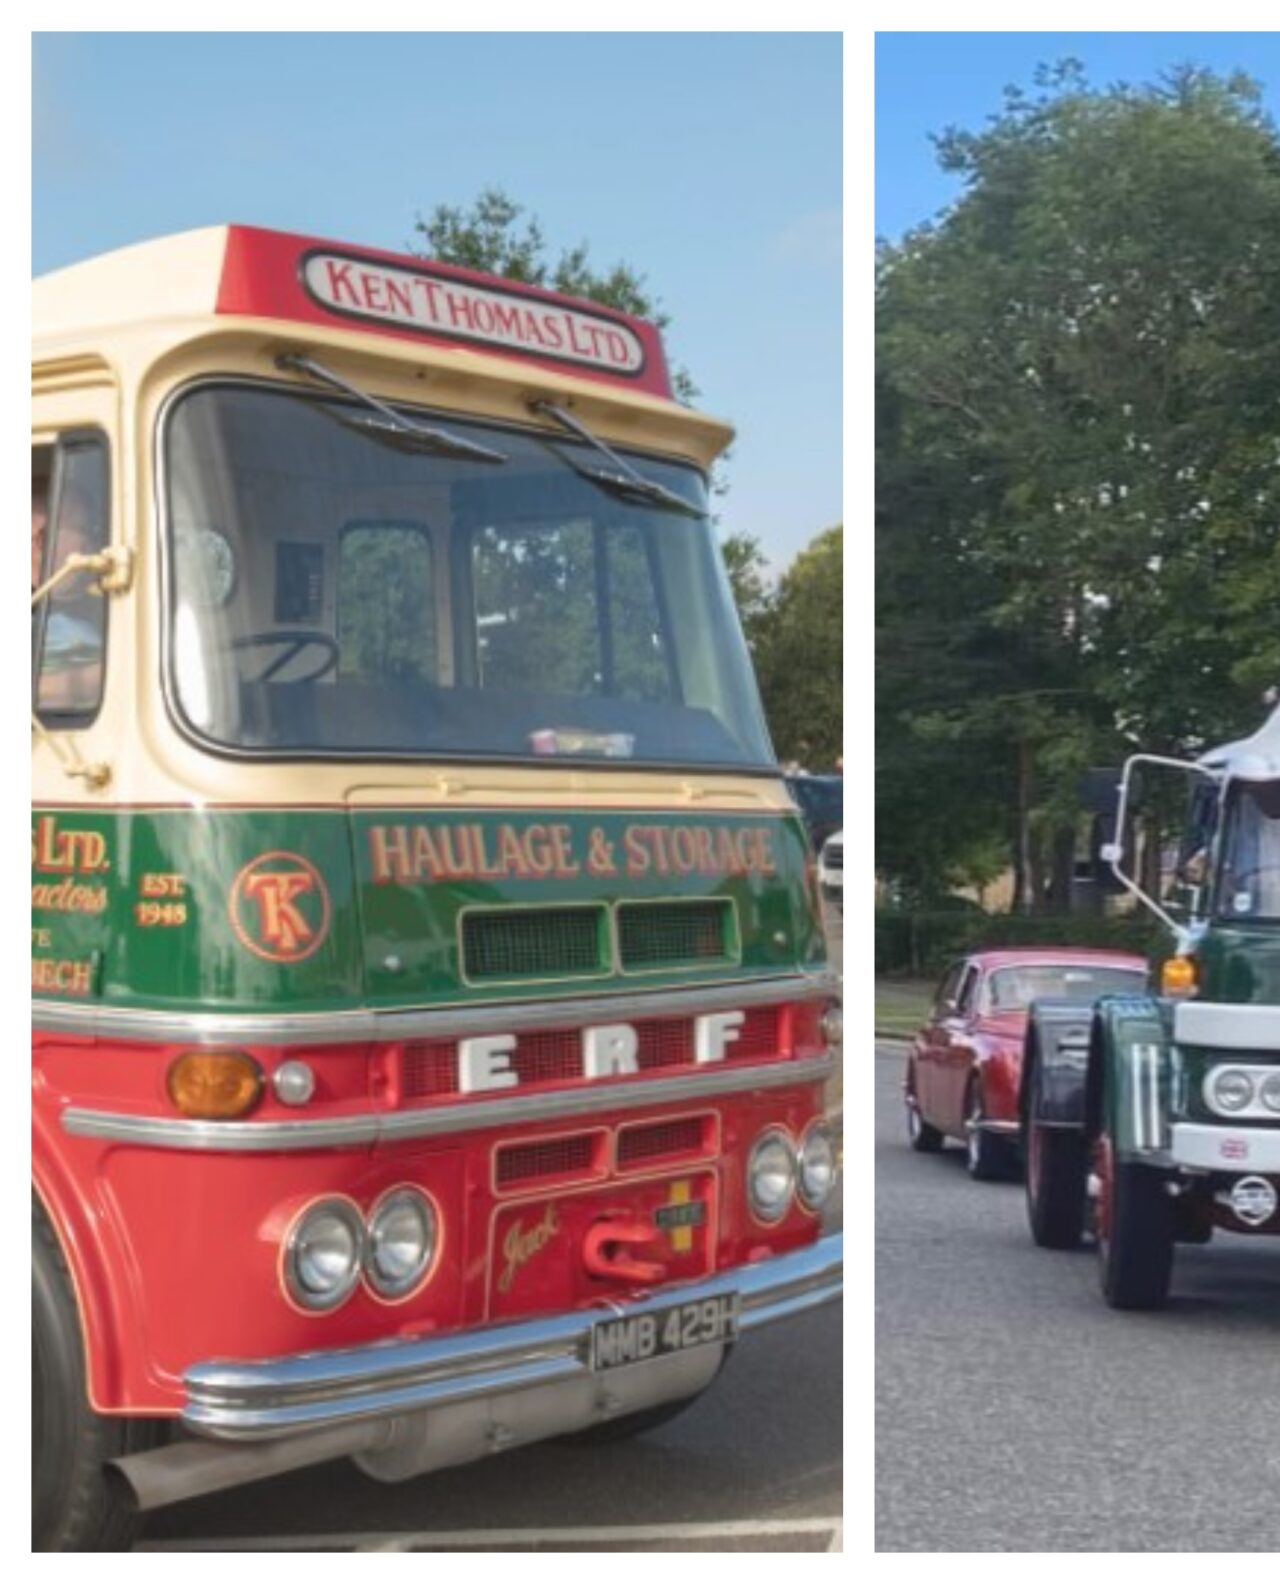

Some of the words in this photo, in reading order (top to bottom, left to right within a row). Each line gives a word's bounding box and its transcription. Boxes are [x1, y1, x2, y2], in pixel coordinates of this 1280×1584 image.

[325, 258, 414, 318] KEN
[413, 276, 564, 350] THOMAS
[562, 312, 636, 367] LTD.
[142, 872, 185, 898] EST.
[368, 823, 580, 885] HAULAGE
[587, 824, 619, 878] &
[622, 825, 778, 878] STORAGE
[596, 1315, 657, 1369] MMB
[662, 1295, 742, 1350] 429H
